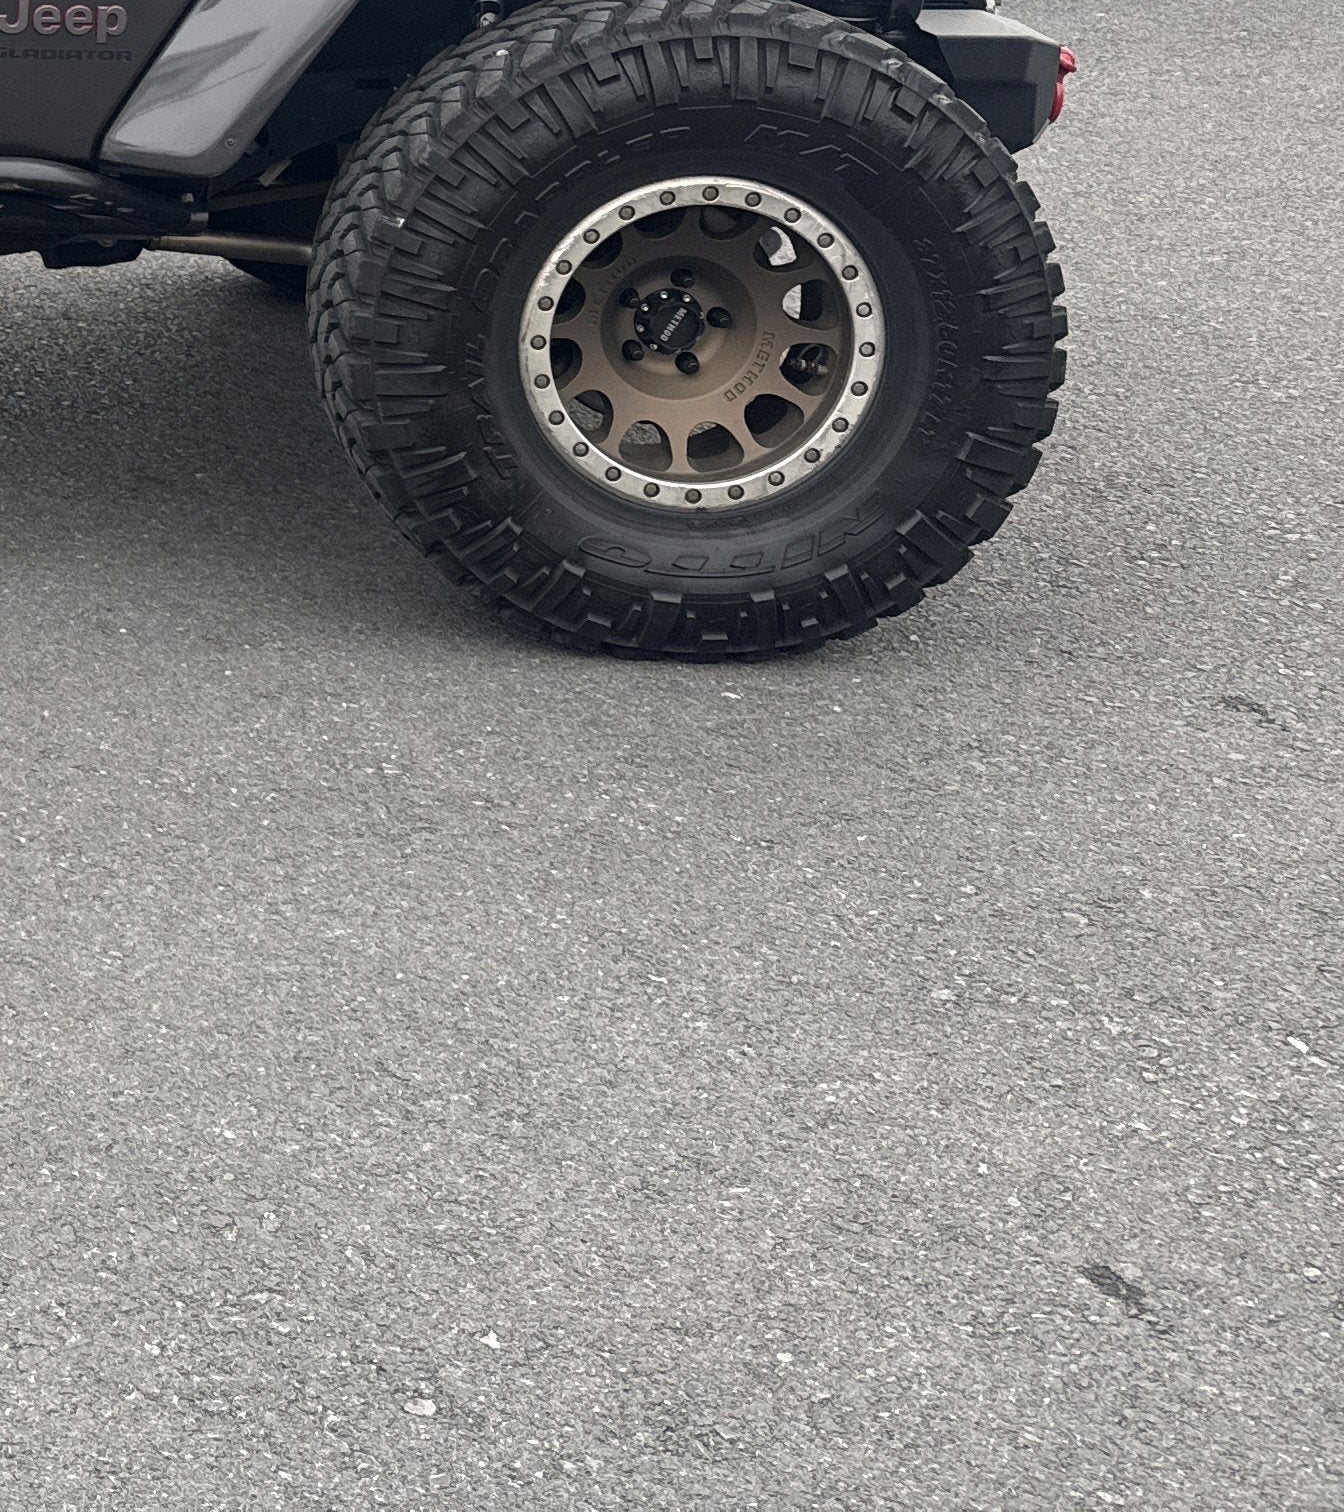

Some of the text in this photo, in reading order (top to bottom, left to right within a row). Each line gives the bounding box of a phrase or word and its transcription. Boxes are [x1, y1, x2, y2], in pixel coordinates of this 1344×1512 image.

[659, 306, 688, 343] METHOD
[722, 332, 776, 403] METHOD
[576, 497, 886, 579] NITTO
